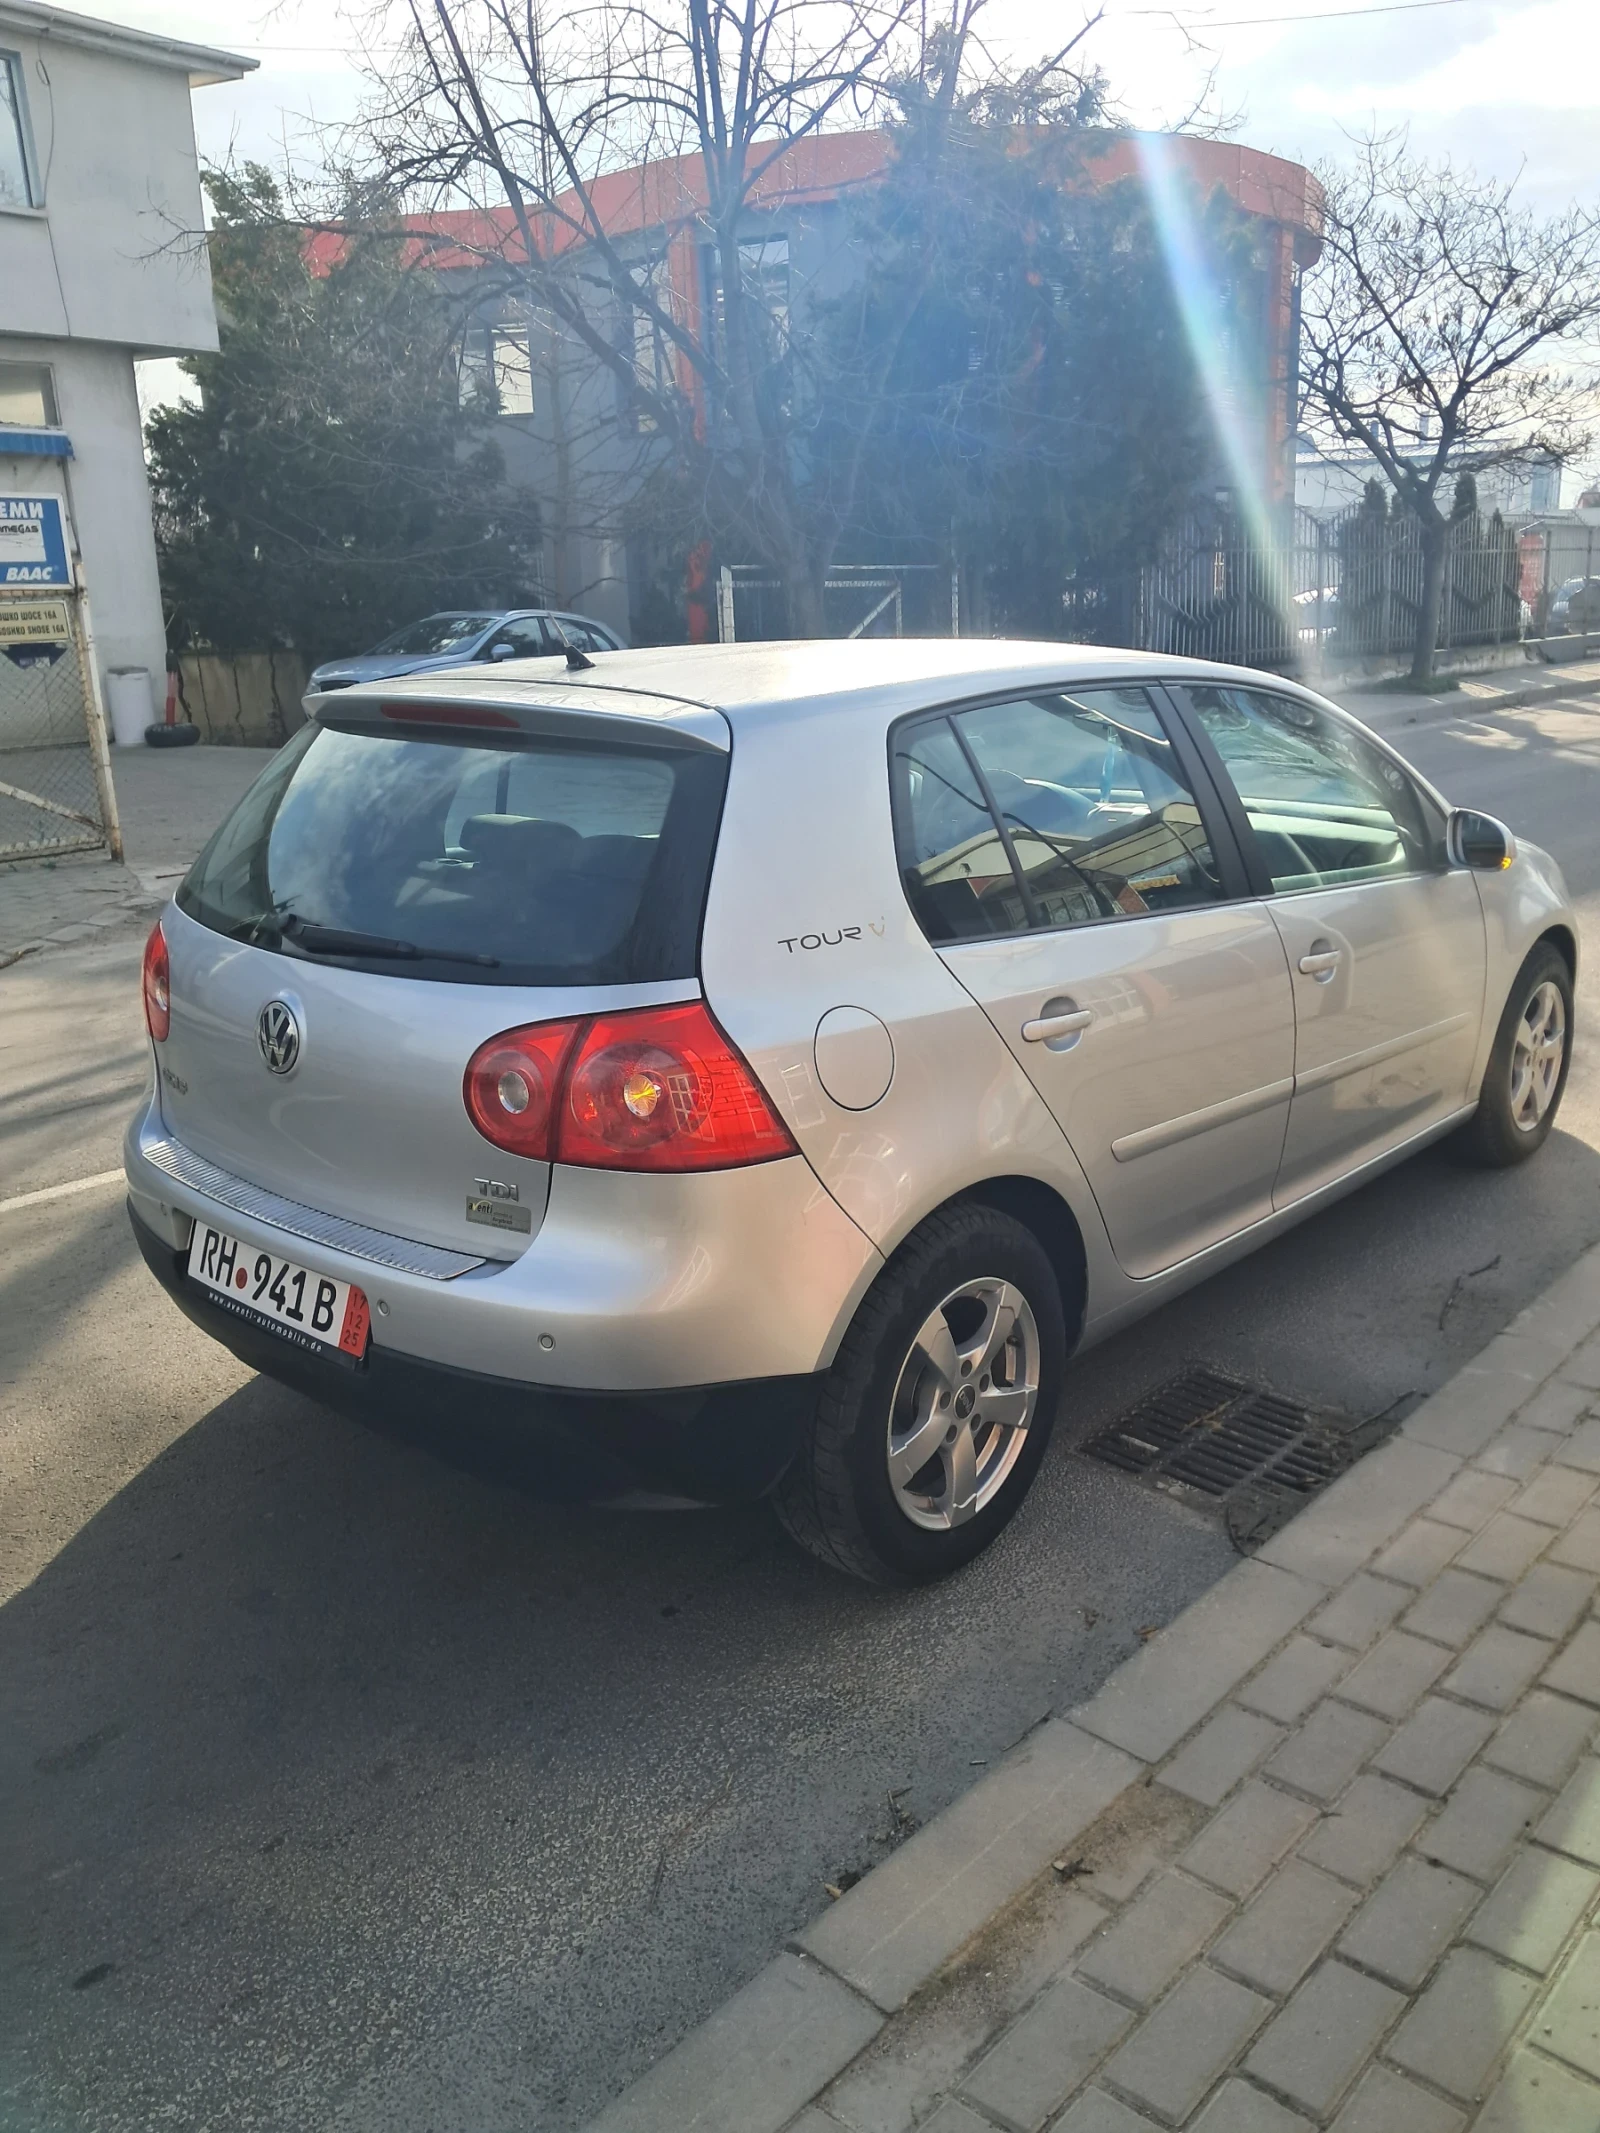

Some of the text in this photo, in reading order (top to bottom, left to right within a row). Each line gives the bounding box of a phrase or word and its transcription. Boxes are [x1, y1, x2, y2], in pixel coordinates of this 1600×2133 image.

[21, 611, 42, 620] ШОСЕ
[28, 624, 50, 634] SHOSE
[777, 926, 862, 953] TOUR
[474, 1177, 519, 1202] TDI
[468, 1201, 493, 1214] aventi
[200, 1228, 238, 1287] RH
[208, 1291, 322, 1352] www.aventi-automobile.de
[349, 1312, 362, 1329] 12
[344, 1330, 359, 1346] 25
